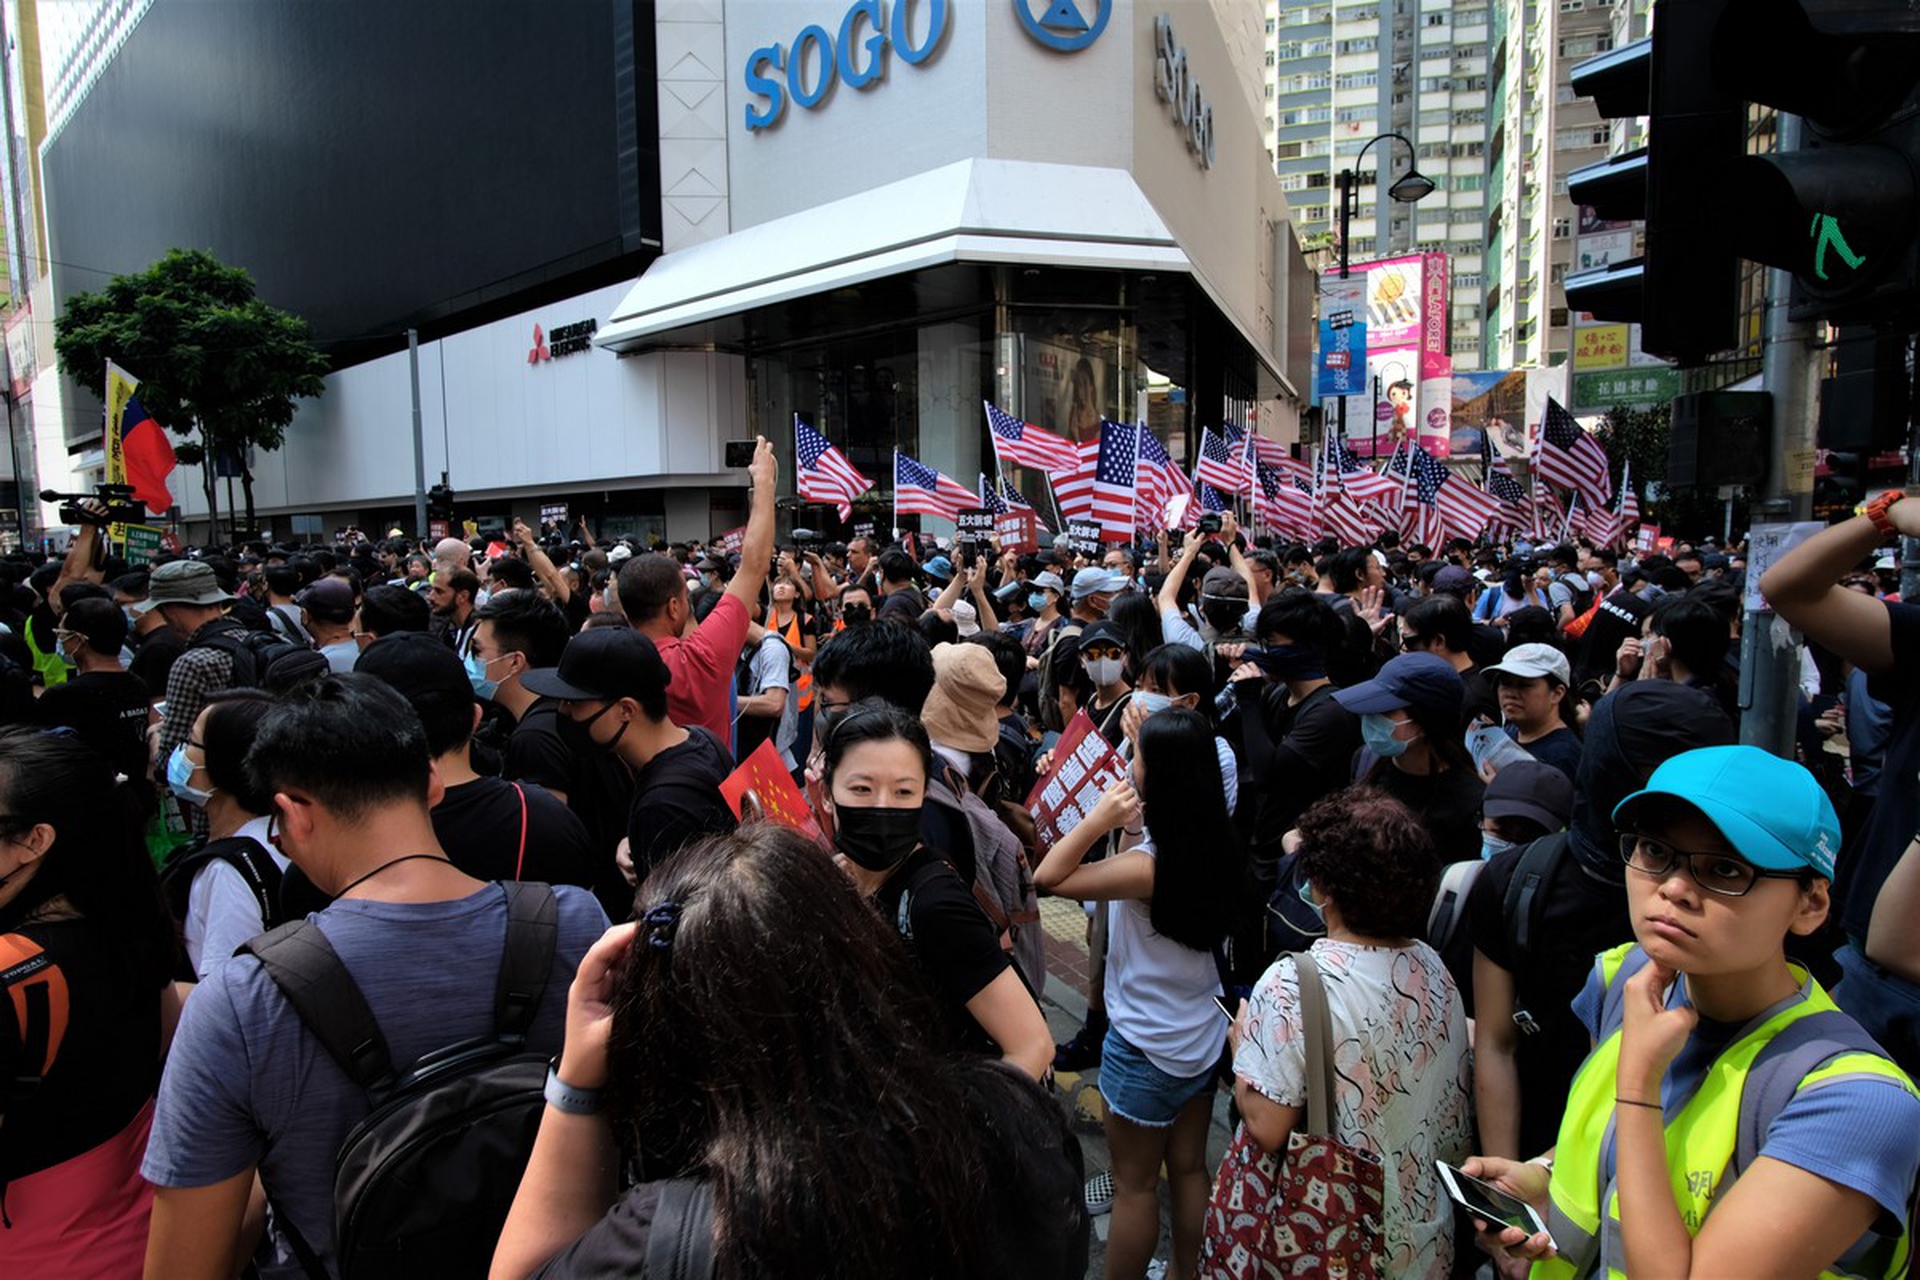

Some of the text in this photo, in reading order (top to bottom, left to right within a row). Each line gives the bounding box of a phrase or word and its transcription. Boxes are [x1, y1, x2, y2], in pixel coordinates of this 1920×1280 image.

[744, 0, 948, 131] SOGO
[958, 515, 993, 528] 五大訴求
